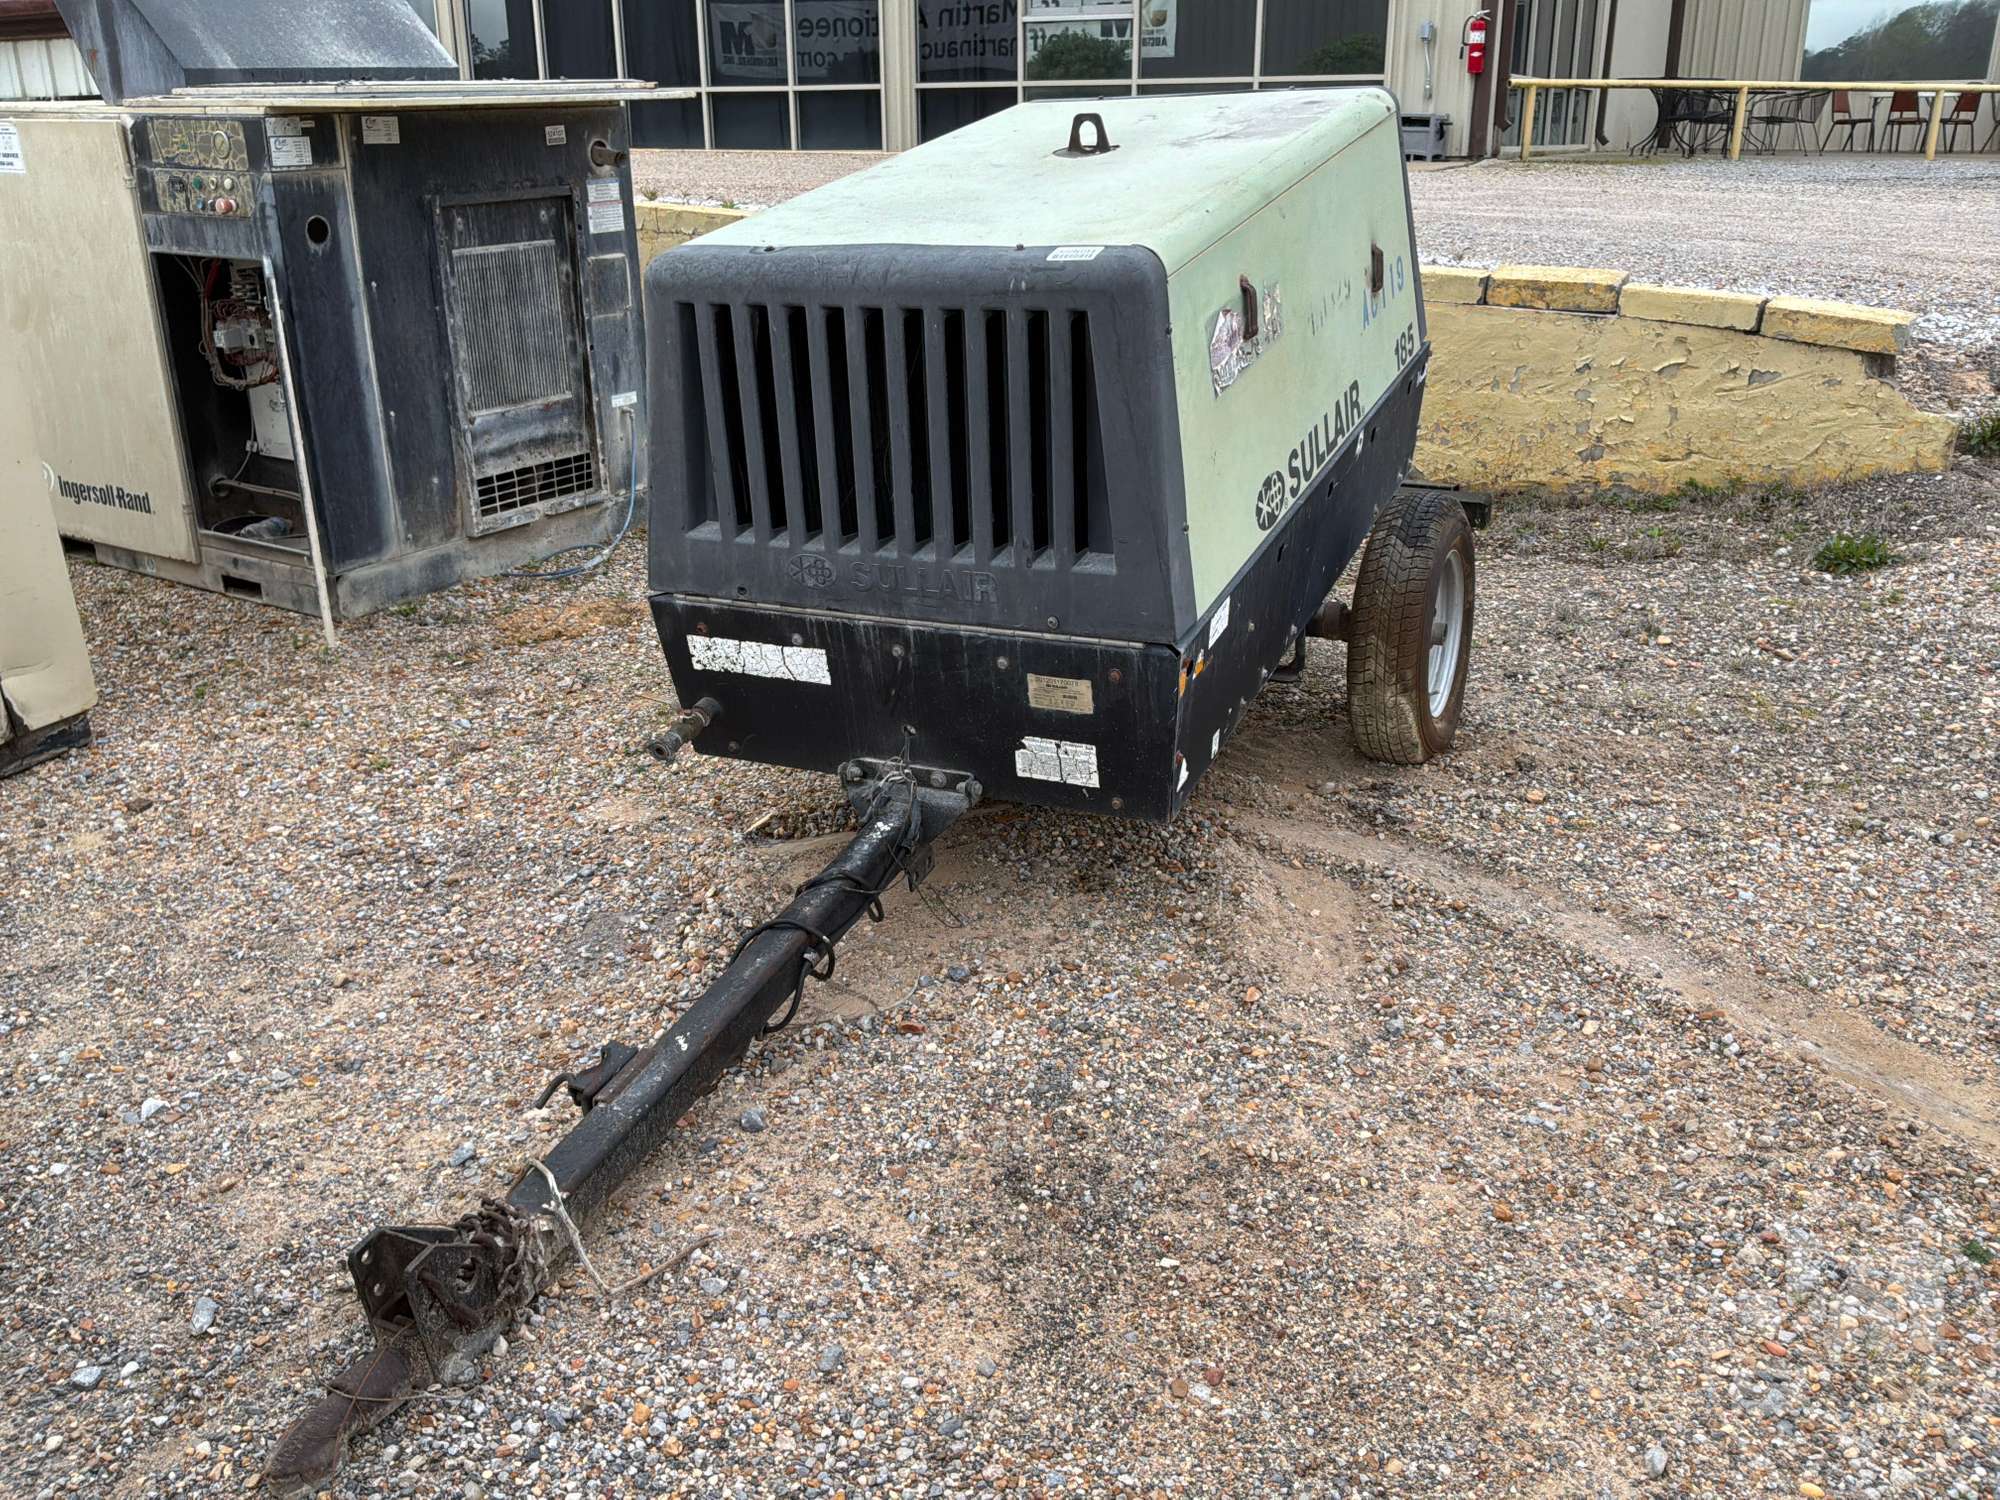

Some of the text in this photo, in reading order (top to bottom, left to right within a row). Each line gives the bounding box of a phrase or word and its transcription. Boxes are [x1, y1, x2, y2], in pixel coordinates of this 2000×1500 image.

[1394, 322, 1415, 372] 185
[1287, 379, 1362, 500] SULLAIR
[850, 560, 1000, 604] SULLAIR
